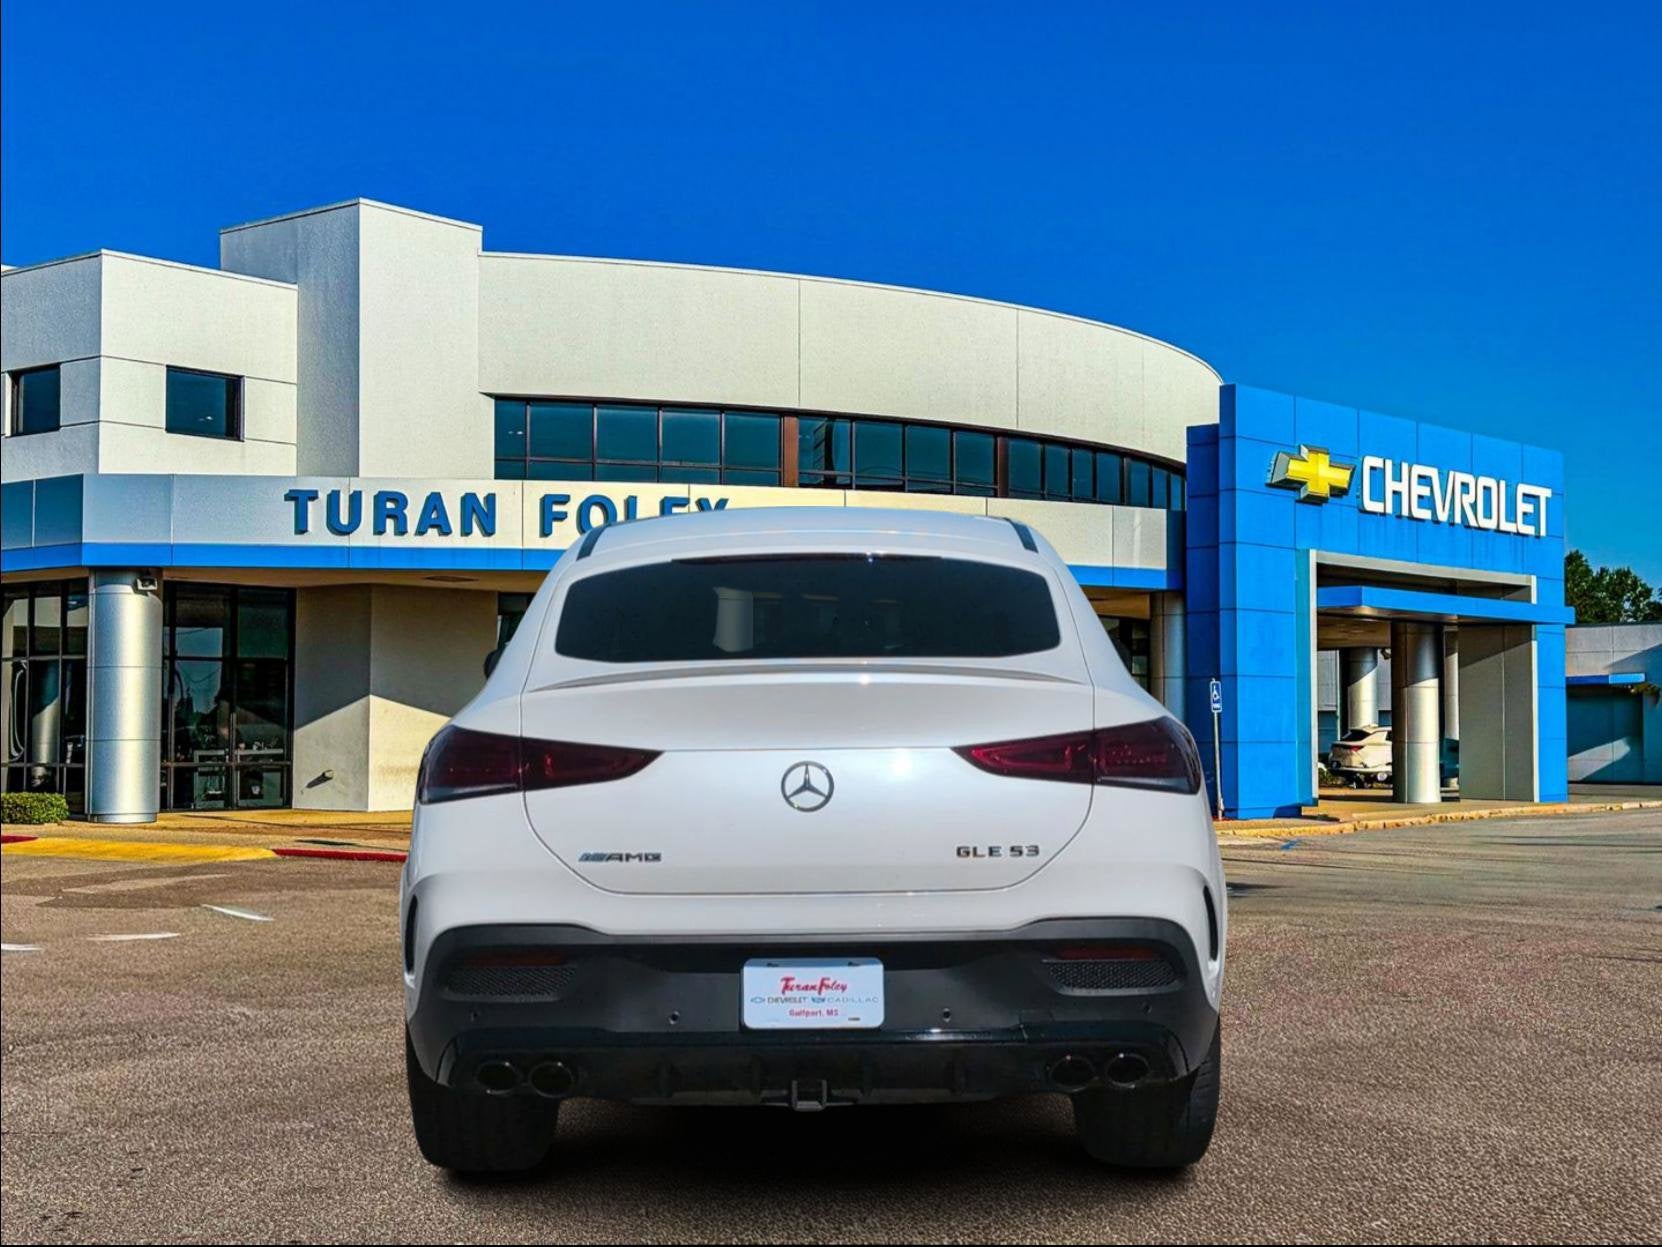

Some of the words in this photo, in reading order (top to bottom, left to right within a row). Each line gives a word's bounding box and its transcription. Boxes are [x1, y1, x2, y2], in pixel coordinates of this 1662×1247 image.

[1361, 455, 1552, 537] CHEVROLET
[284, 489, 496, 537] TURAN
[603, 852, 662, 862] AMG
[956, 846, 1003, 858] GLE
